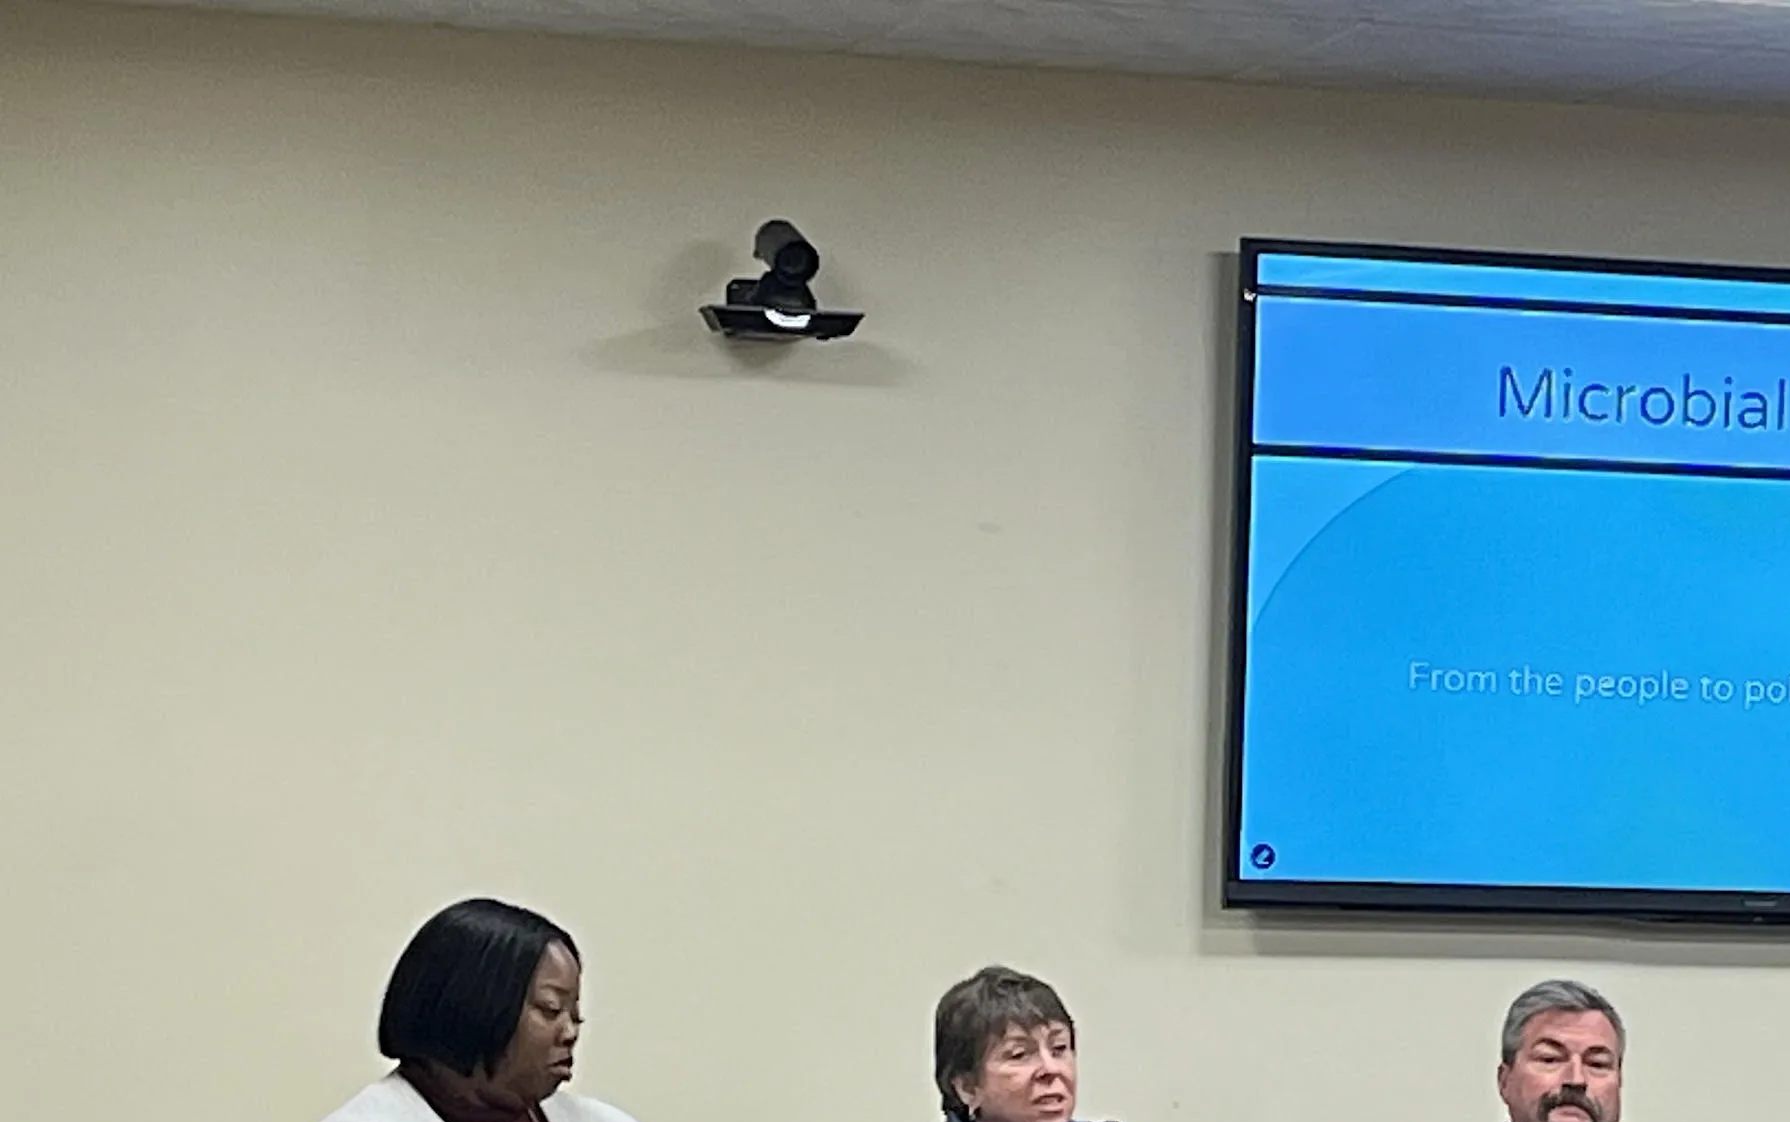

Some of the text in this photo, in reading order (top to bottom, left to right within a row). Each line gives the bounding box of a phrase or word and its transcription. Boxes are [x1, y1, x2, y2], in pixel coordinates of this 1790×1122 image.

[1499, 366, 1786, 431] Microbial
[1408, 661, 1498, 693] From
[1508, 664, 1564, 696] the
[1574, 669, 1690, 705] people
[1699, 676, 1735, 702] to
